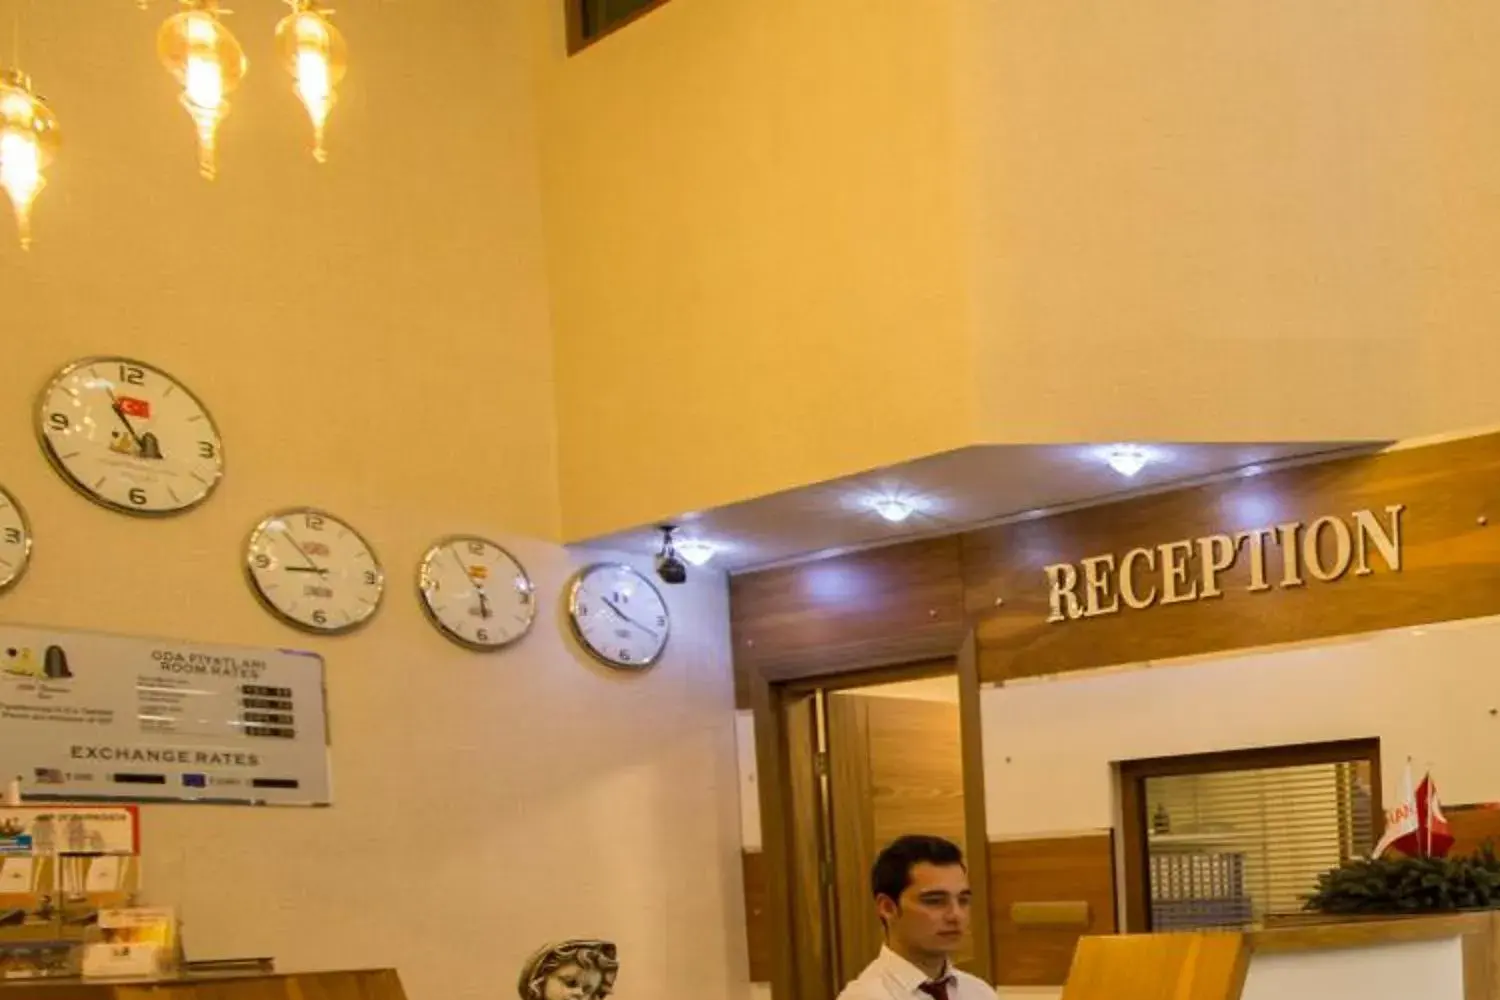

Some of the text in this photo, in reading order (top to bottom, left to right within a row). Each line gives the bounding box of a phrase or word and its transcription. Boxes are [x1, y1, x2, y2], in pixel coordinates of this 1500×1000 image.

[119, 366, 145, 387] 12
[51, 413, 69, 431] 9
[197, 441, 216, 459] 3
[128, 488, 148, 505] 6
[305, 513, 325, 531] 12
[1044, 503, 1405, 623] RECEPTION
[312, 609, 328, 625] 6
[160, 661, 206, 675] ROOM
[70, 744, 260, 767] EXCHANGE RATES
